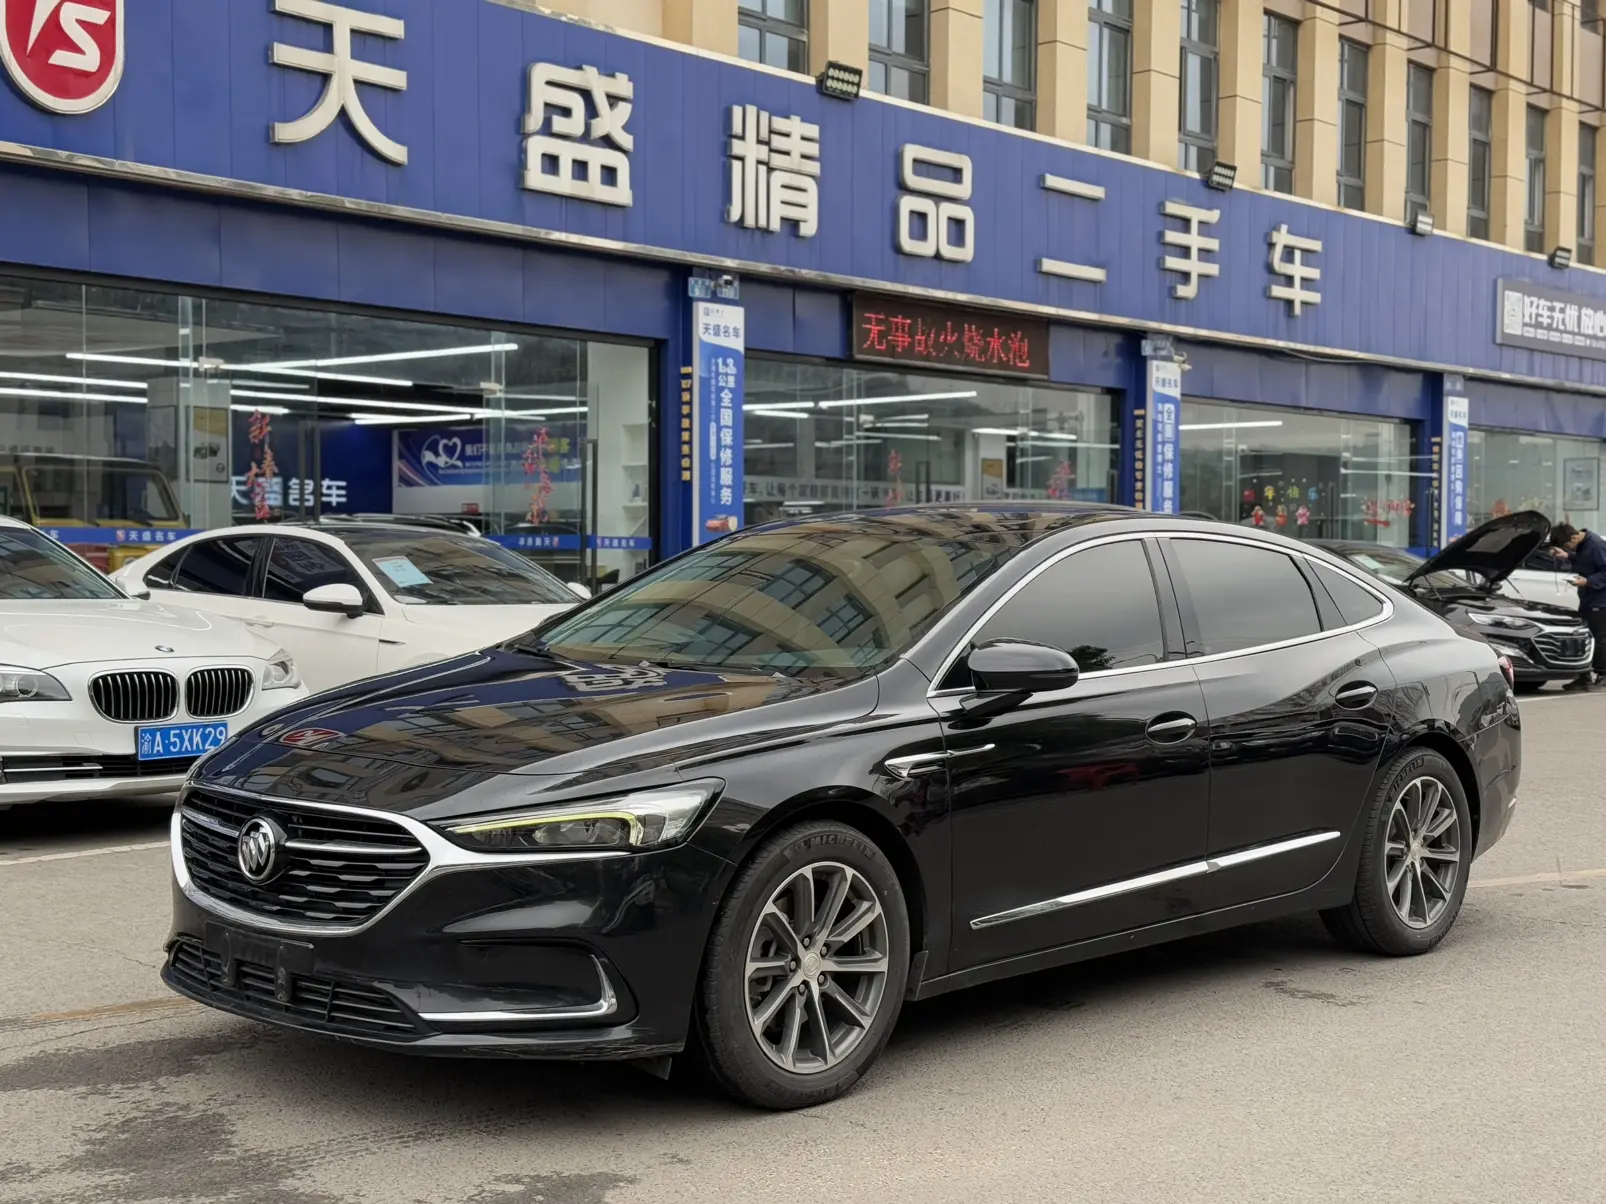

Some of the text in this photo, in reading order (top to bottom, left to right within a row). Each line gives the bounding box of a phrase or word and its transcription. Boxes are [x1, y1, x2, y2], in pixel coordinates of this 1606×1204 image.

[270, 0, 1323, 316] 天盛精品二手车
[862, 313, 1030, 368] 无事故火烧水泡
